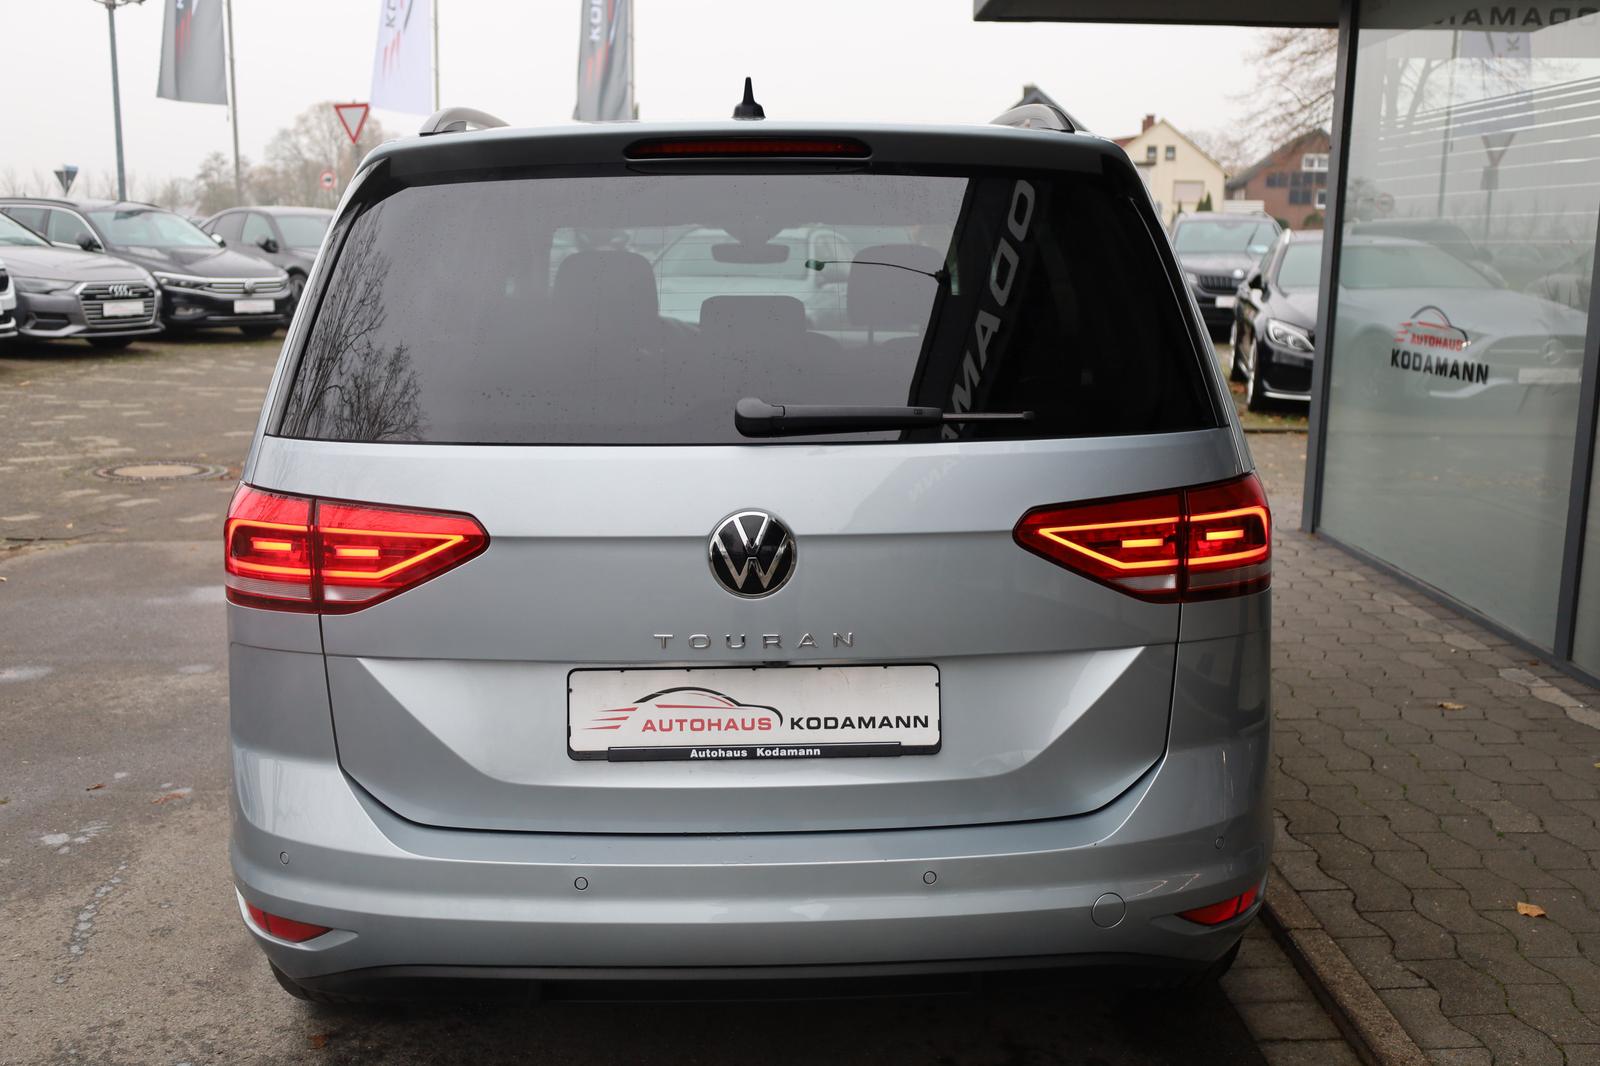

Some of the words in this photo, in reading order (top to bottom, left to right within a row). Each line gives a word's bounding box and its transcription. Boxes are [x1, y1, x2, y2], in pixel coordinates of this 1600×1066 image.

[1410, 333, 1464, 352] AUTOHAUS
[1391, 348, 1489, 384] KODAMANN
[653, 632, 854, 650] TOURAN
[641, 716, 773, 733] AUTOHAUS
[789, 714, 930, 731] KODAMANN
[689, 747, 748, 759] Autohaus
[756, 745, 822, 758] Kodamann
